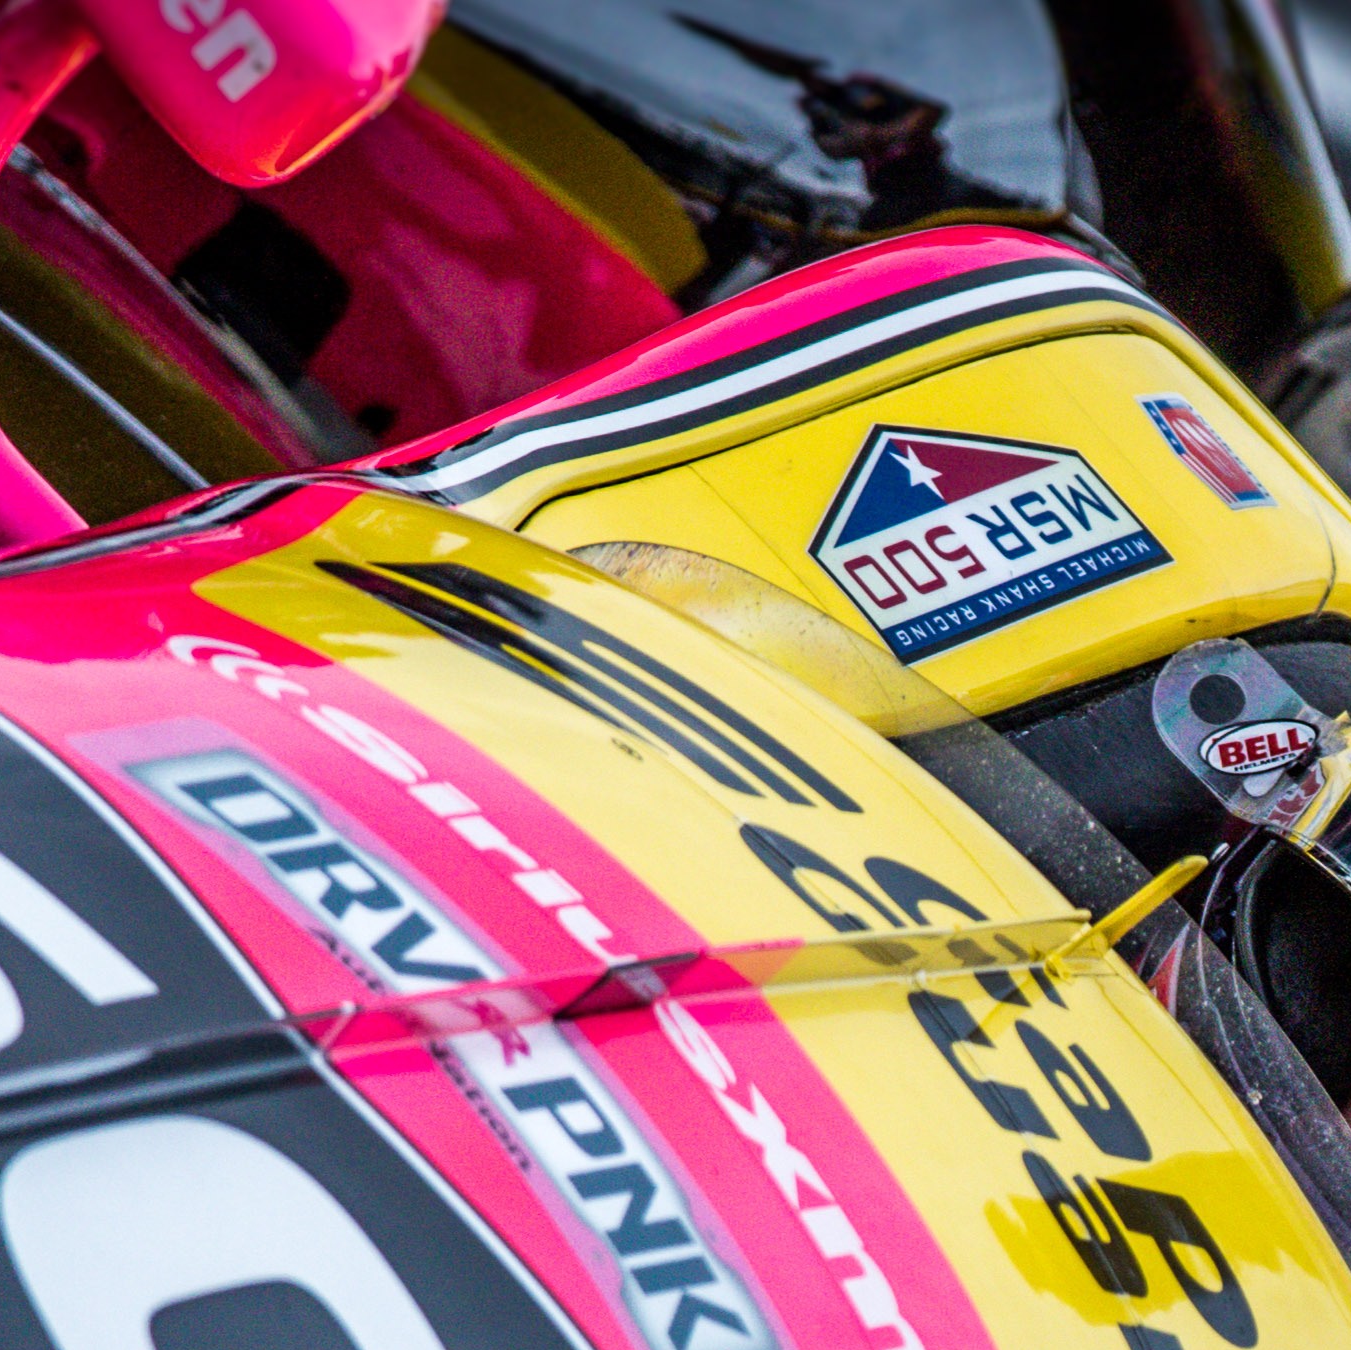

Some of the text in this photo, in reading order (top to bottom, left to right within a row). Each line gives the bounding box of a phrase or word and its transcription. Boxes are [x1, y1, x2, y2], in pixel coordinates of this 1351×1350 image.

[843, 473, 1119, 610] MSR 500
[894, 537, 1149, 647] MICHAEL SHANK RACING
[1217, 727, 1310, 769] BELL
[1233, 753, 1298, 773] HELMETS
